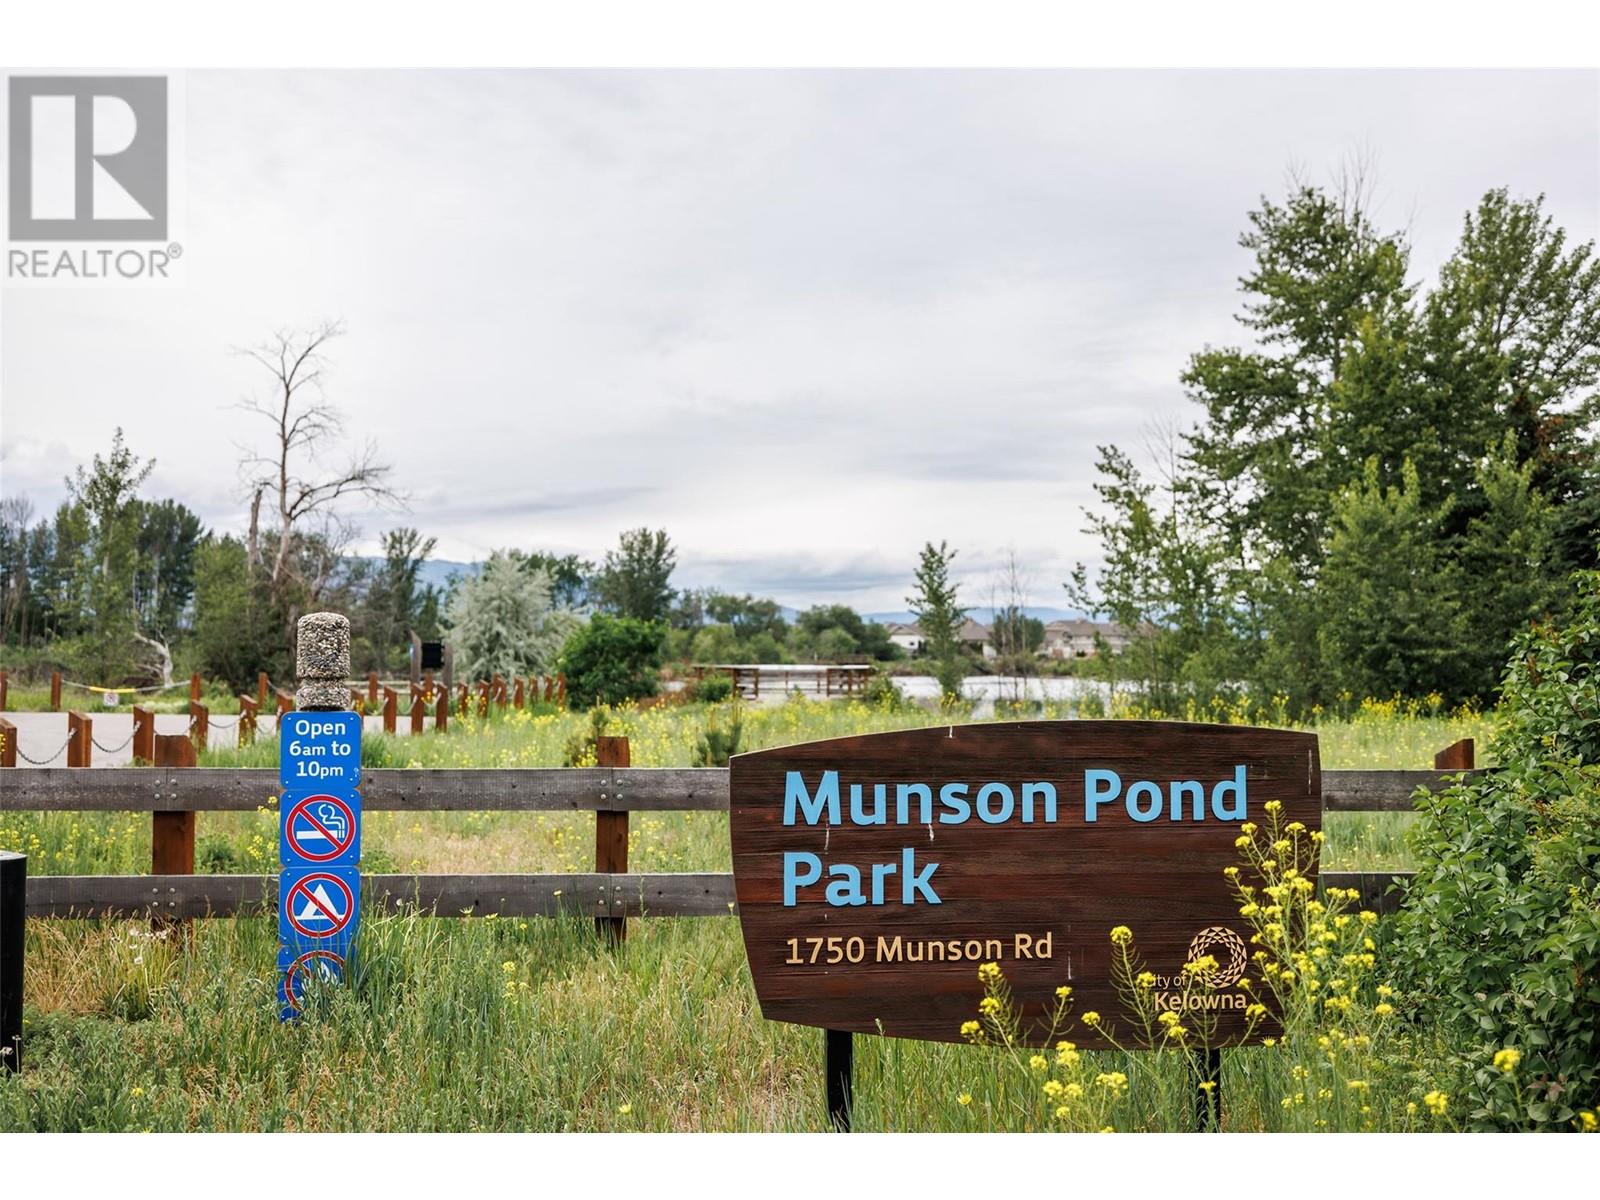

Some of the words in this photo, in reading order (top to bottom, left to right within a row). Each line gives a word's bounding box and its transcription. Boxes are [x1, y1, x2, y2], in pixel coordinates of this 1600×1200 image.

[295, 719, 346, 739] Open
[289, 740, 326, 756] 6am
[331, 740, 351, 756] to
[296, 761, 344, 780] 10pm
[783, 770, 1057, 826] Munson
[1084, 764, 1248, 822] Pond
[783, 847, 943, 907] Park
[785, 937, 866, 965] 1750
[876, 934, 1003, 964] Munson
[1014, 931, 1053, 960] Rd
[1145, 974, 1171, 989] ity
[1173, 974, 1187, 987] of
[1154, 991, 1247, 1011] Kelowna
